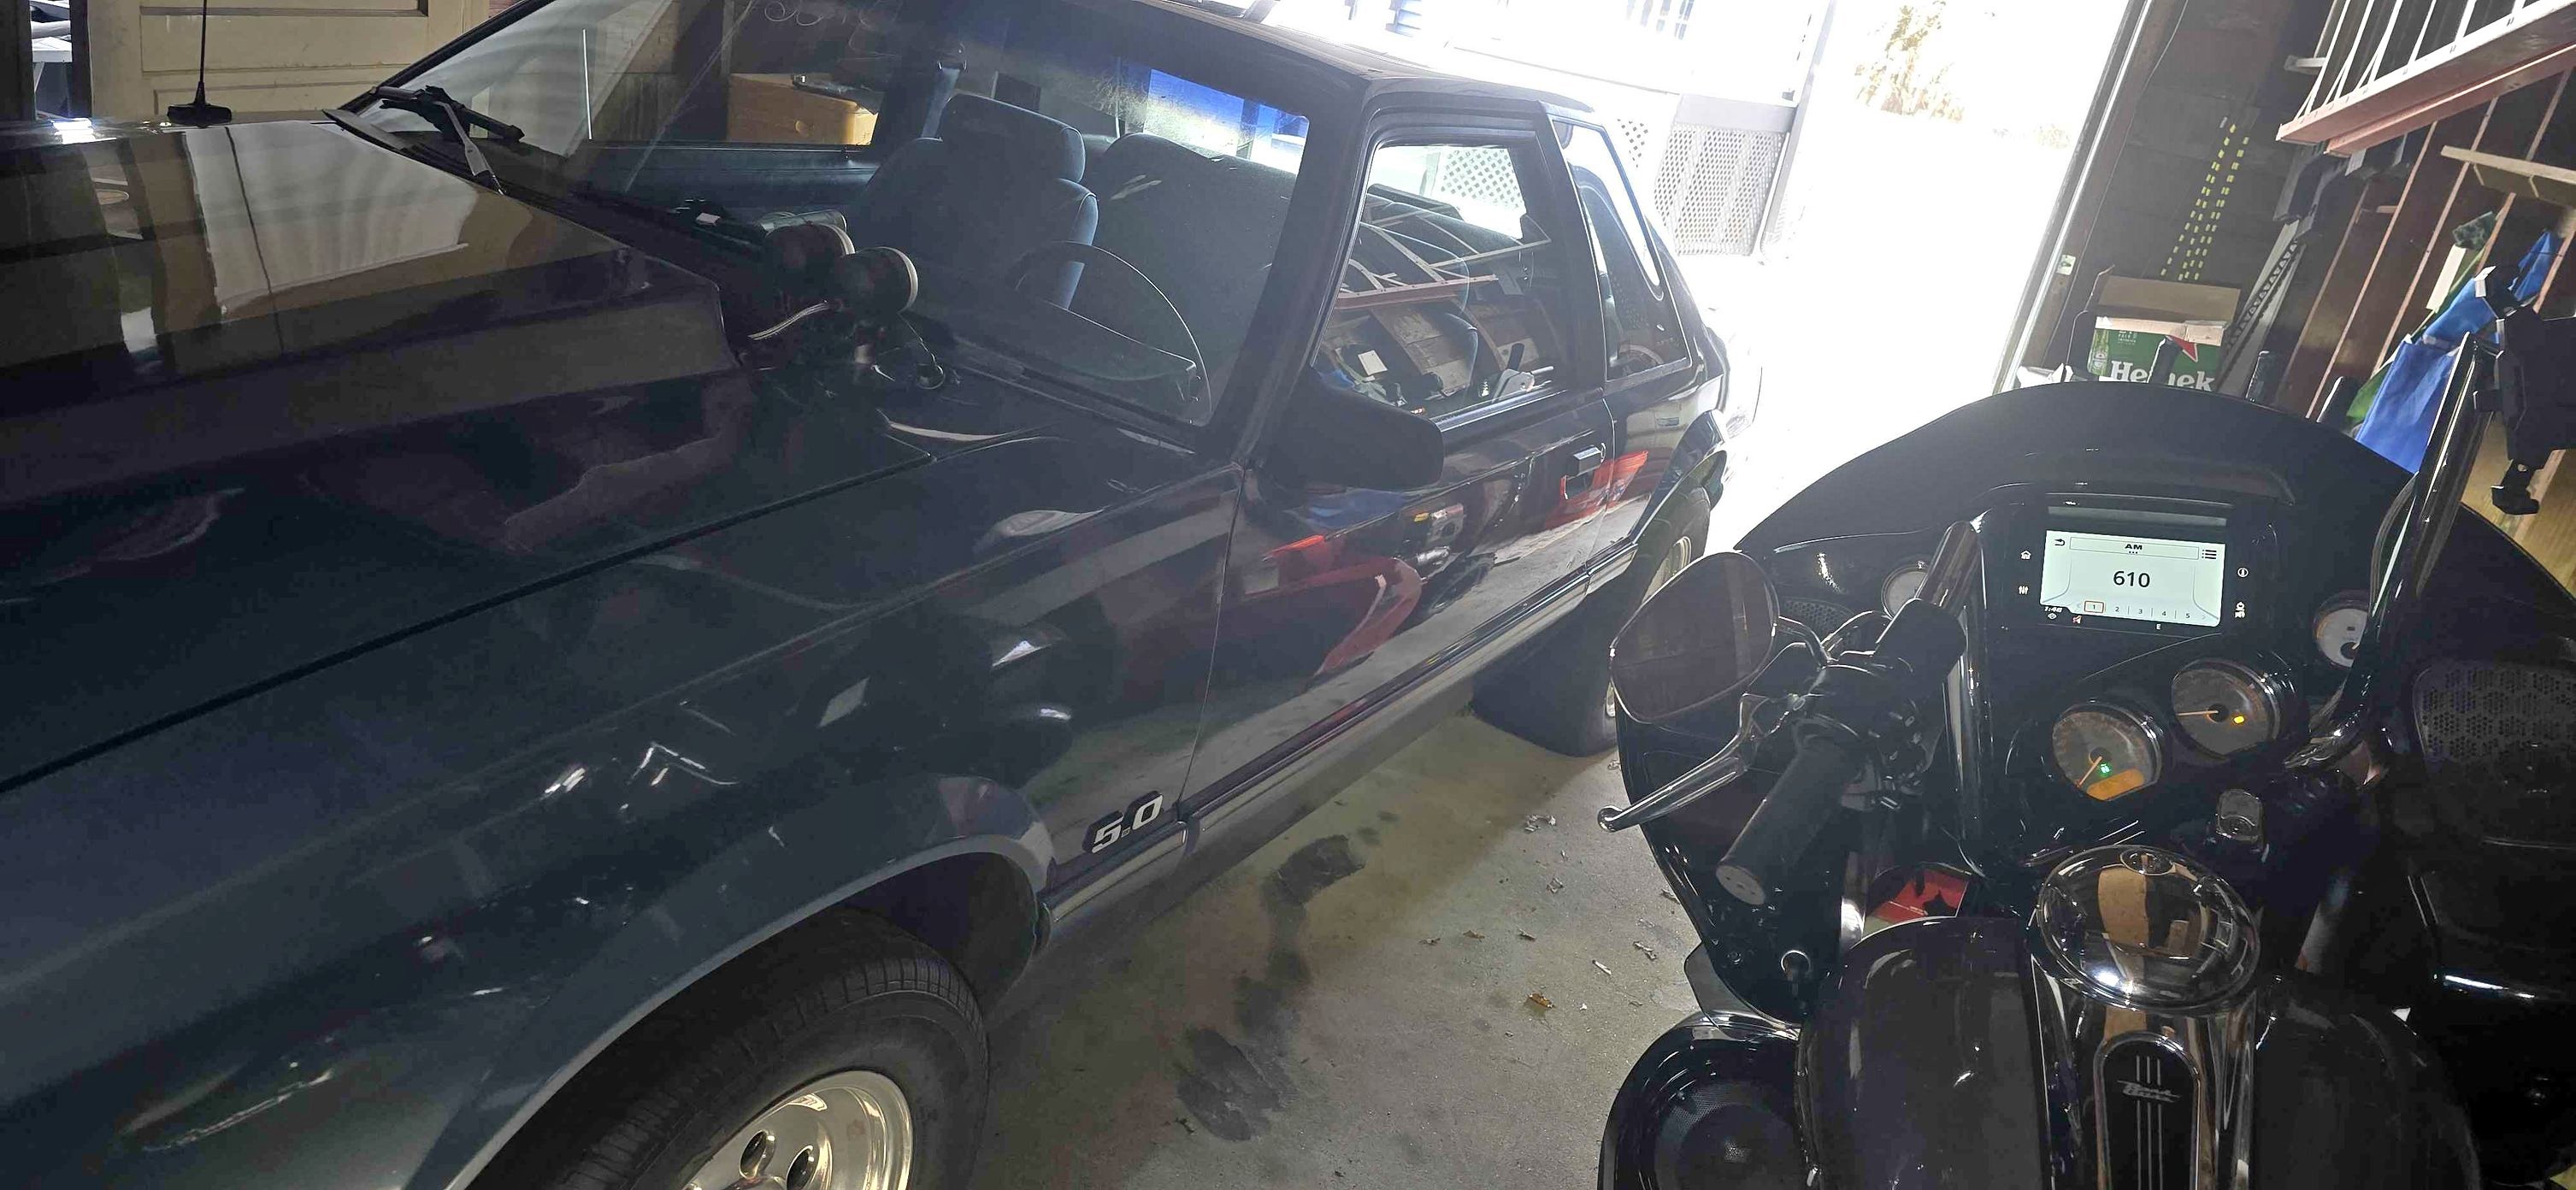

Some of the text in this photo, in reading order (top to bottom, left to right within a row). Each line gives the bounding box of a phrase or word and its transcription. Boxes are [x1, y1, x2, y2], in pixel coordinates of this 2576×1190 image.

[2110, 360, 2215, 392] Heek
[2113, 570, 2150, 588] 610
[1091, 793, 1164, 854] 5.0
